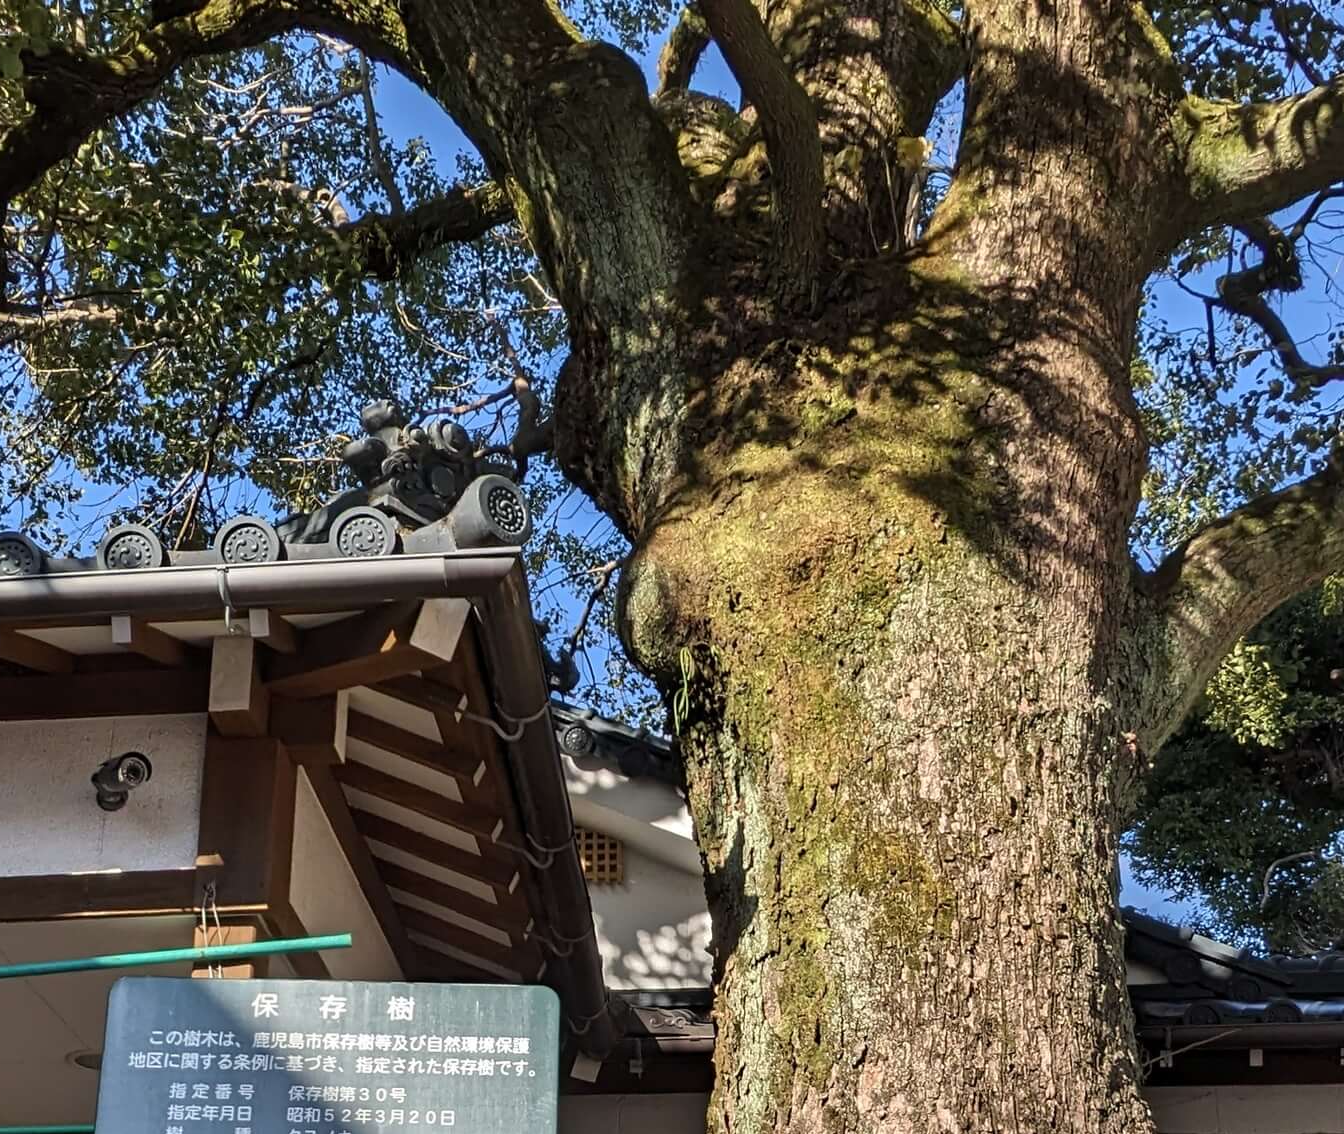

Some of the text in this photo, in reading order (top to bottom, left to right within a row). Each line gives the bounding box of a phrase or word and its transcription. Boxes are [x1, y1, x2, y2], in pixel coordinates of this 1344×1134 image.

[251, 993, 416, 1021] 保存樹
[149, 1029, 531, 1055] この樹木は、鹿児島市保存樹等及び自然環境保護
[128, 1052, 537, 1078] 地区に関する条例に基づき、指定された保存樹です。
[169, 1082, 255, 1100] 指定番号
[167, 1104, 253, 1121] 指定年月日
